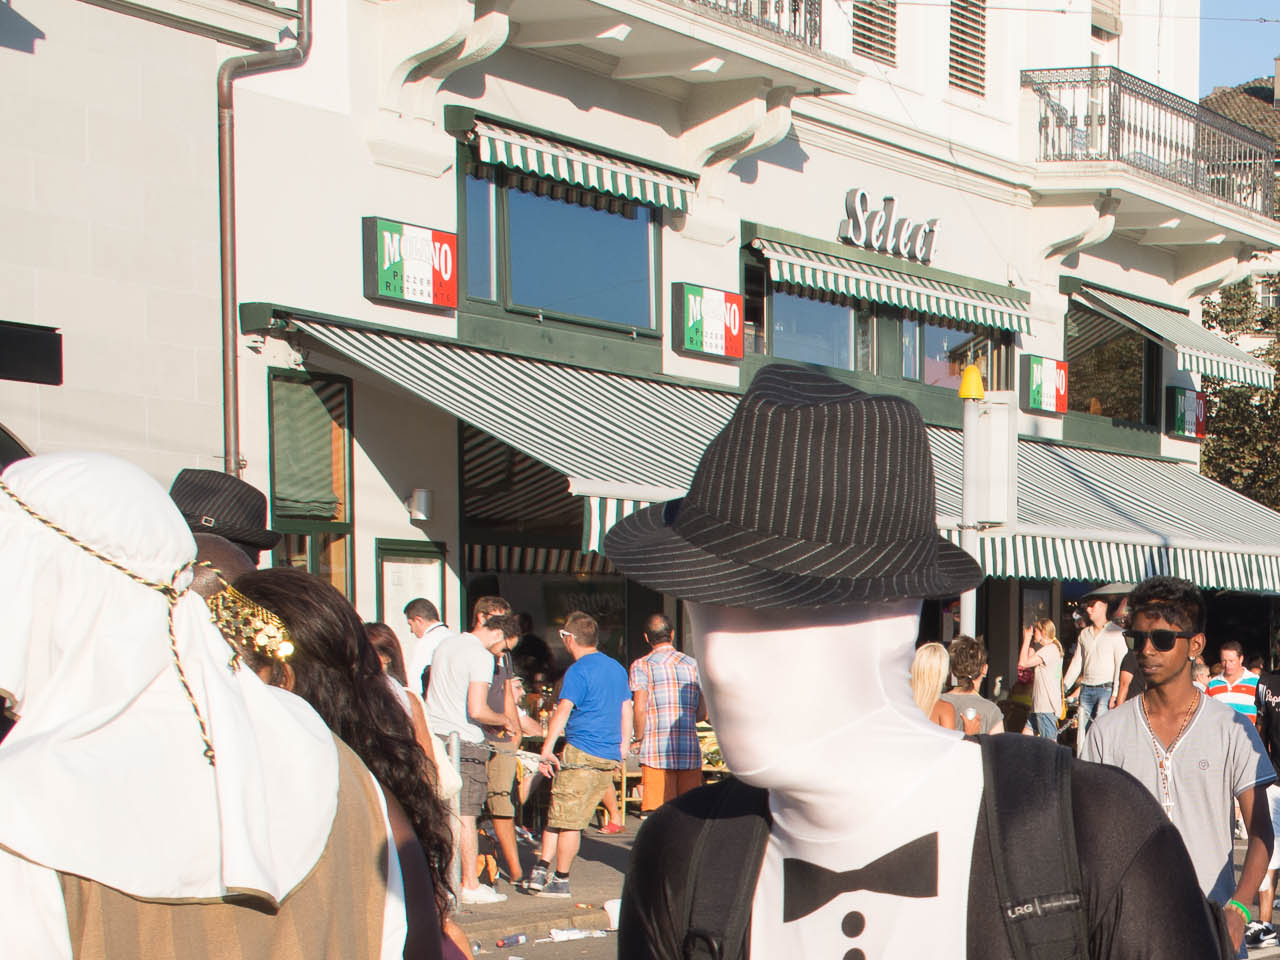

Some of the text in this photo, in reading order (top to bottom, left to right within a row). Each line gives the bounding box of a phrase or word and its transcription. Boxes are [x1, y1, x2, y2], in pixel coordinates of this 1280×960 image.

[838, 187, 941, 266] Select
[393, 270, 443, 288] PIZZERA
[687, 293, 740, 337] MNO
[1007, 905, 1033, 918] LRG
